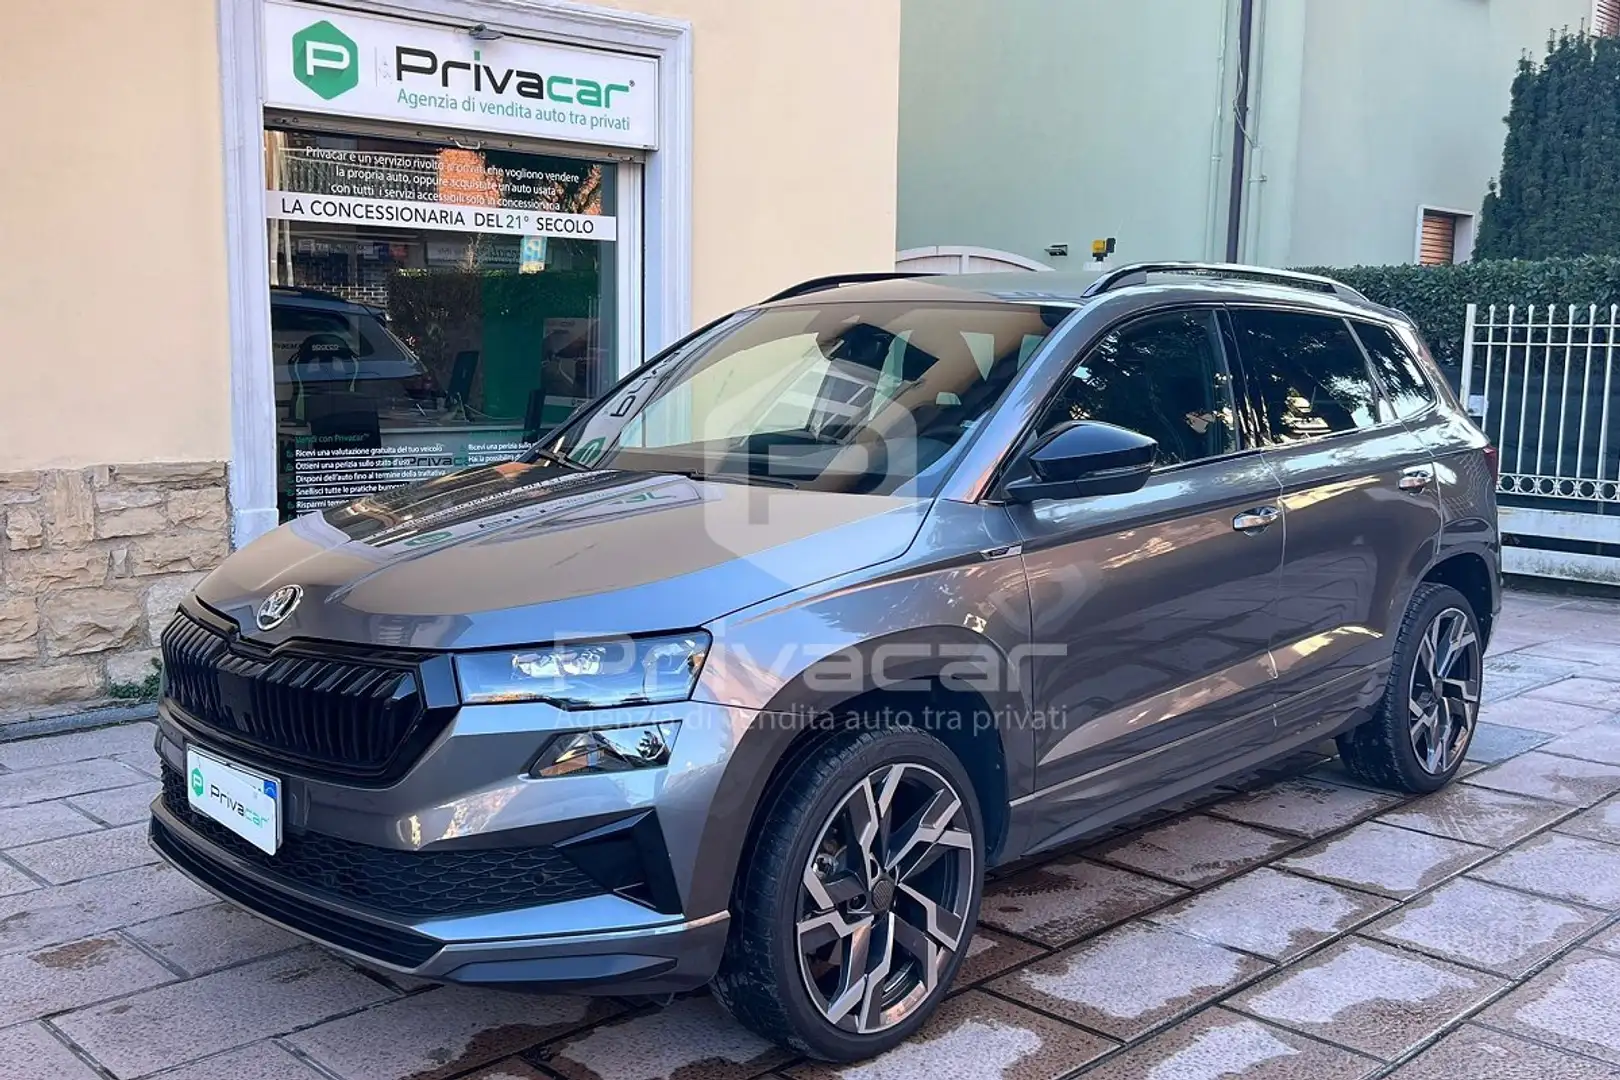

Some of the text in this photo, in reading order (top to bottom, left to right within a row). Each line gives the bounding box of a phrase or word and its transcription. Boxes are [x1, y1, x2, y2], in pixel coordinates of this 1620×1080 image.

[305, 40, 350, 76] P
[397, 88, 630, 130] Agenzia di vendita auto tra privati
[306, 146, 347, 161] Privacar
[357, 154, 371, 164] un
[374, 155, 412, 168] servizio
[413, 158, 444, 170] rivolto
[487, 164, 504, 176] che
[505, 167, 544, 181] vogliono
[545, 171, 580, 184] vendere
[336, 165, 345, 177] la
[347, 170, 384, 181] propria
[386, 173, 411, 184] auto,
[413, 175, 449, 187] oppure
[498, 183, 532, 193] un'auto
[533, 186, 556, 196] usata
[331, 183, 350, 193] con
[352, 185, 374, 196] tutti
[385, 188, 415, 199] servizi
[417, 191, 465, 203] accessibili
[466, 194, 484, 205] solo
[497, 198, 560, 211] concessionaria
[281, 198, 305, 214] LA
[310, 200, 466, 226] CONCESSIONARIA
[474, 212, 503, 228] DEL
[537, 217, 594, 234] SECOLO
[295, 449, 316, 457] Ricevi
[331, 447, 370, 456] valutazione
[397, 445, 407, 454] del
[408, 445, 419, 453] tuo
[295, 474, 322, 484] Disponi
[354, 471, 367, 480] fino
[368, 471, 374, 479] al
[375, 470, 401, 479] termine
[321, 462, 334, 470] una
[342, 485, 349, 493] le
[295, 499, 326, 509] Risparmi
[210, 784, 269, 828] Privacar
